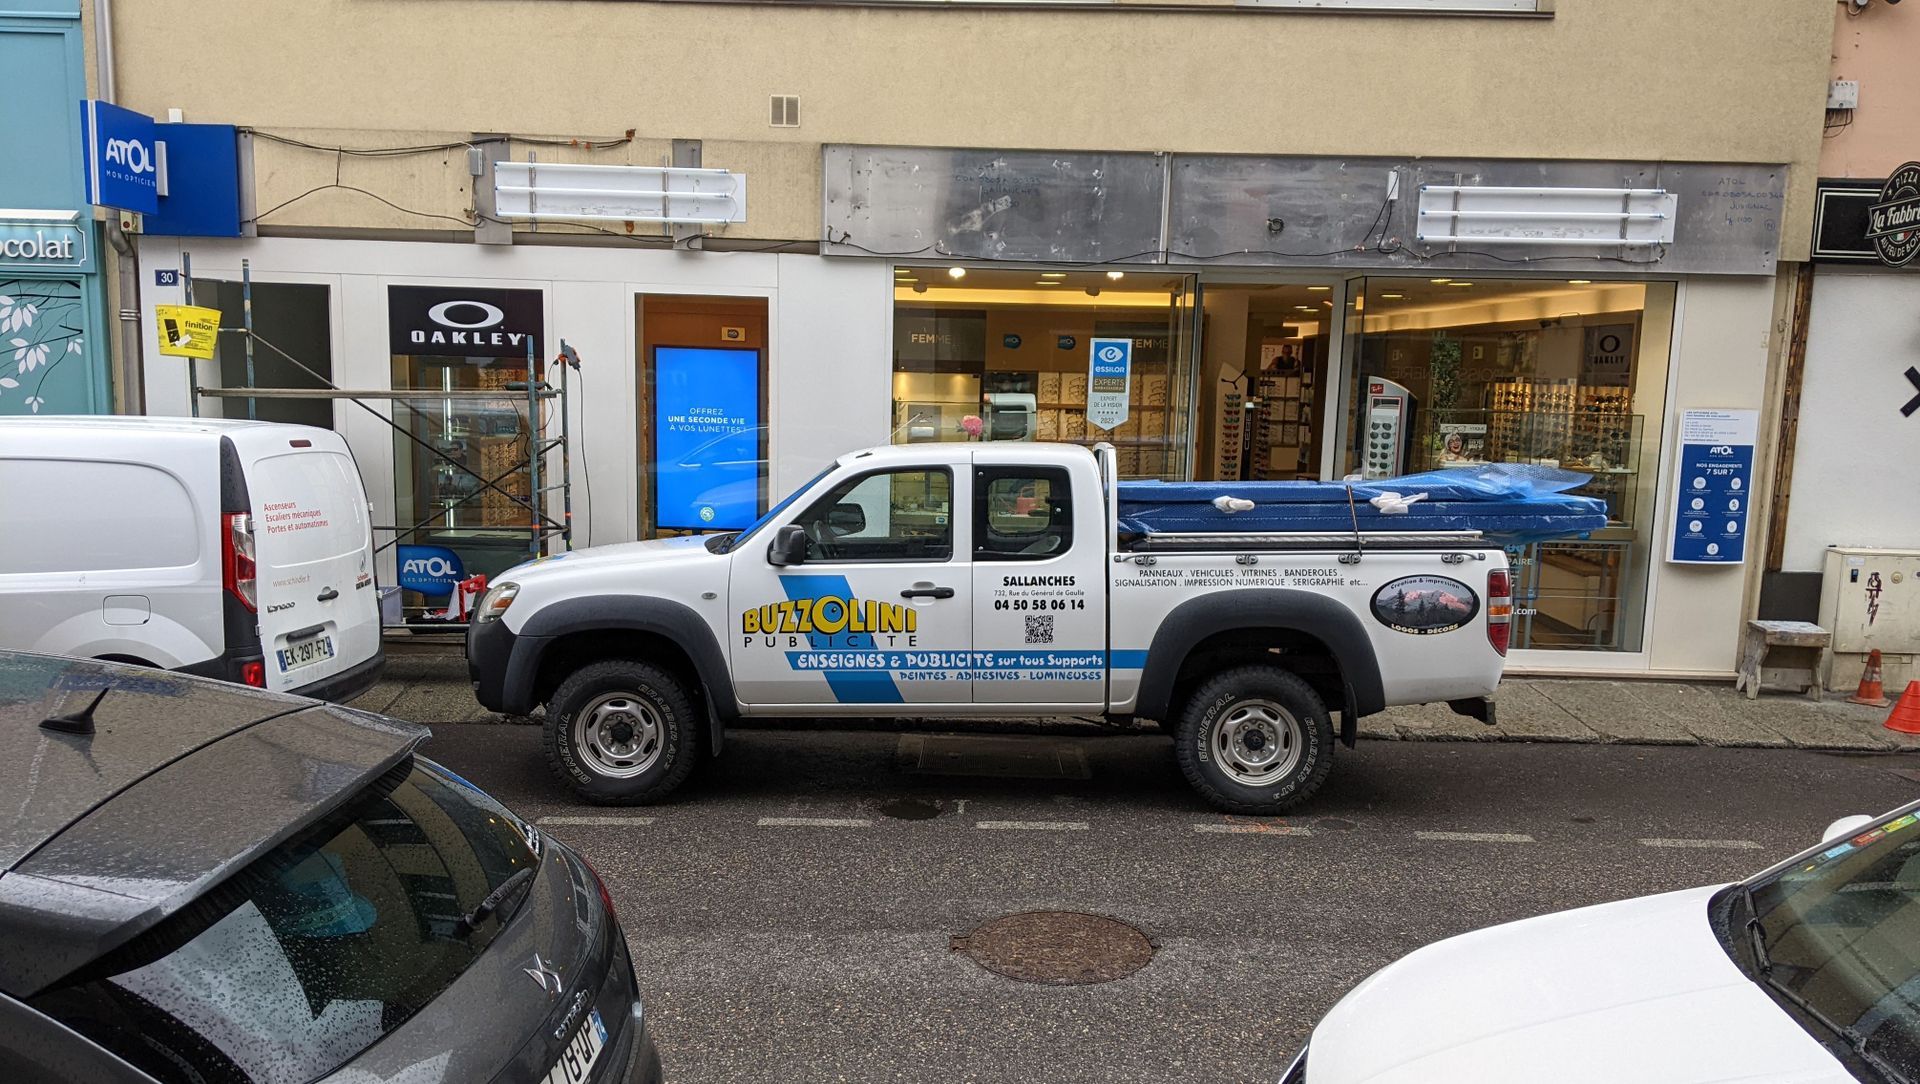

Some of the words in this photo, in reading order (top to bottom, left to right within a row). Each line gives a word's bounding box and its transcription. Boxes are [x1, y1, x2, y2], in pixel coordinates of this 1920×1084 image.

[106, 138, 154, 173] ATOL
[106, 170, 122, 179] MON
[125, 174, 155, 187] OPTICIEN
[1895, 172, 1918, 188] PIZZA
[1873, 210, 1885, 232] La
[0, 230, 74, 258] colat
[1887, 245, 1897, 257] FEU
[1897, 246, 1906, 257] DE
[160, 273, 174, 284] 30
[185, 320, 213, 332] finition
[411, 330, 522, 346] OAKLEY
[911, 333, 952, 345] FEMME
[1094, 378, 1125, 386] EXPERTS
[689, 407, 724, 415] OFFREZ
[688, 416, 728, 424] SECONDE
[1100, 417, 1115, 425] 2022
[698, 425, 741, 433] LUNETTES
[1710, 446, 1734, 455] ATOL
[264, 502, 297, 512] Ascenseurs
[265, 513, 291, 522] Escaliers
[267, 524, 287, 534] Portes
[403, 557, 457, 577] ATOL
[1139, 569, 1184, 577] PANNEAUX
[1190, 569, 1234, 577] VEHICULES
[1241, 569, 1278, 577] VITRINES
[1284, 569, 1338, 577] BANDEROLES
[1003, 576, 1076, 586] SALLANCHES
[1114, 578, 1177, 587] SIGNALISATION
[1184, 578, 1233, 587] IMPRESSION
[1235, 578, 1286, 587] NUMERIQUE
[1293, 578, 1345, 586] SERIGRAPHIE
[994, 599, 1010, 610] 04
[1013, 599, 1028, 610] 50
[1032, 599, 1047, 610] 58
[1050, 599, 1066, 610] 06
[1070, 599, 1085, 610] 14
[743, 595, 917, 635] BUZZOLINI
[1391, 623, 1419, 634] LOGOS
[744, 635, 917, 648] PUBLICITE
[797, 653, 886, 668] ENSEIGNES
[890, 656, 901, 667] &
[905, 653, 994, 668] PUBLICITE
[998, 656, 1017, 666] sur
[1019, 655, 1044, 666] tous
[1047, 653, 1104, 668] Supports
[900, 671, 947, 681] PEINTES
[956, 671, 1020, 681] ADHESIVES
[1029, 671, 1102, 681] LUMINEUSES
[1198, 692, 1236, 762] GENERAL
[559, 713, 592, 784] GENERAL
